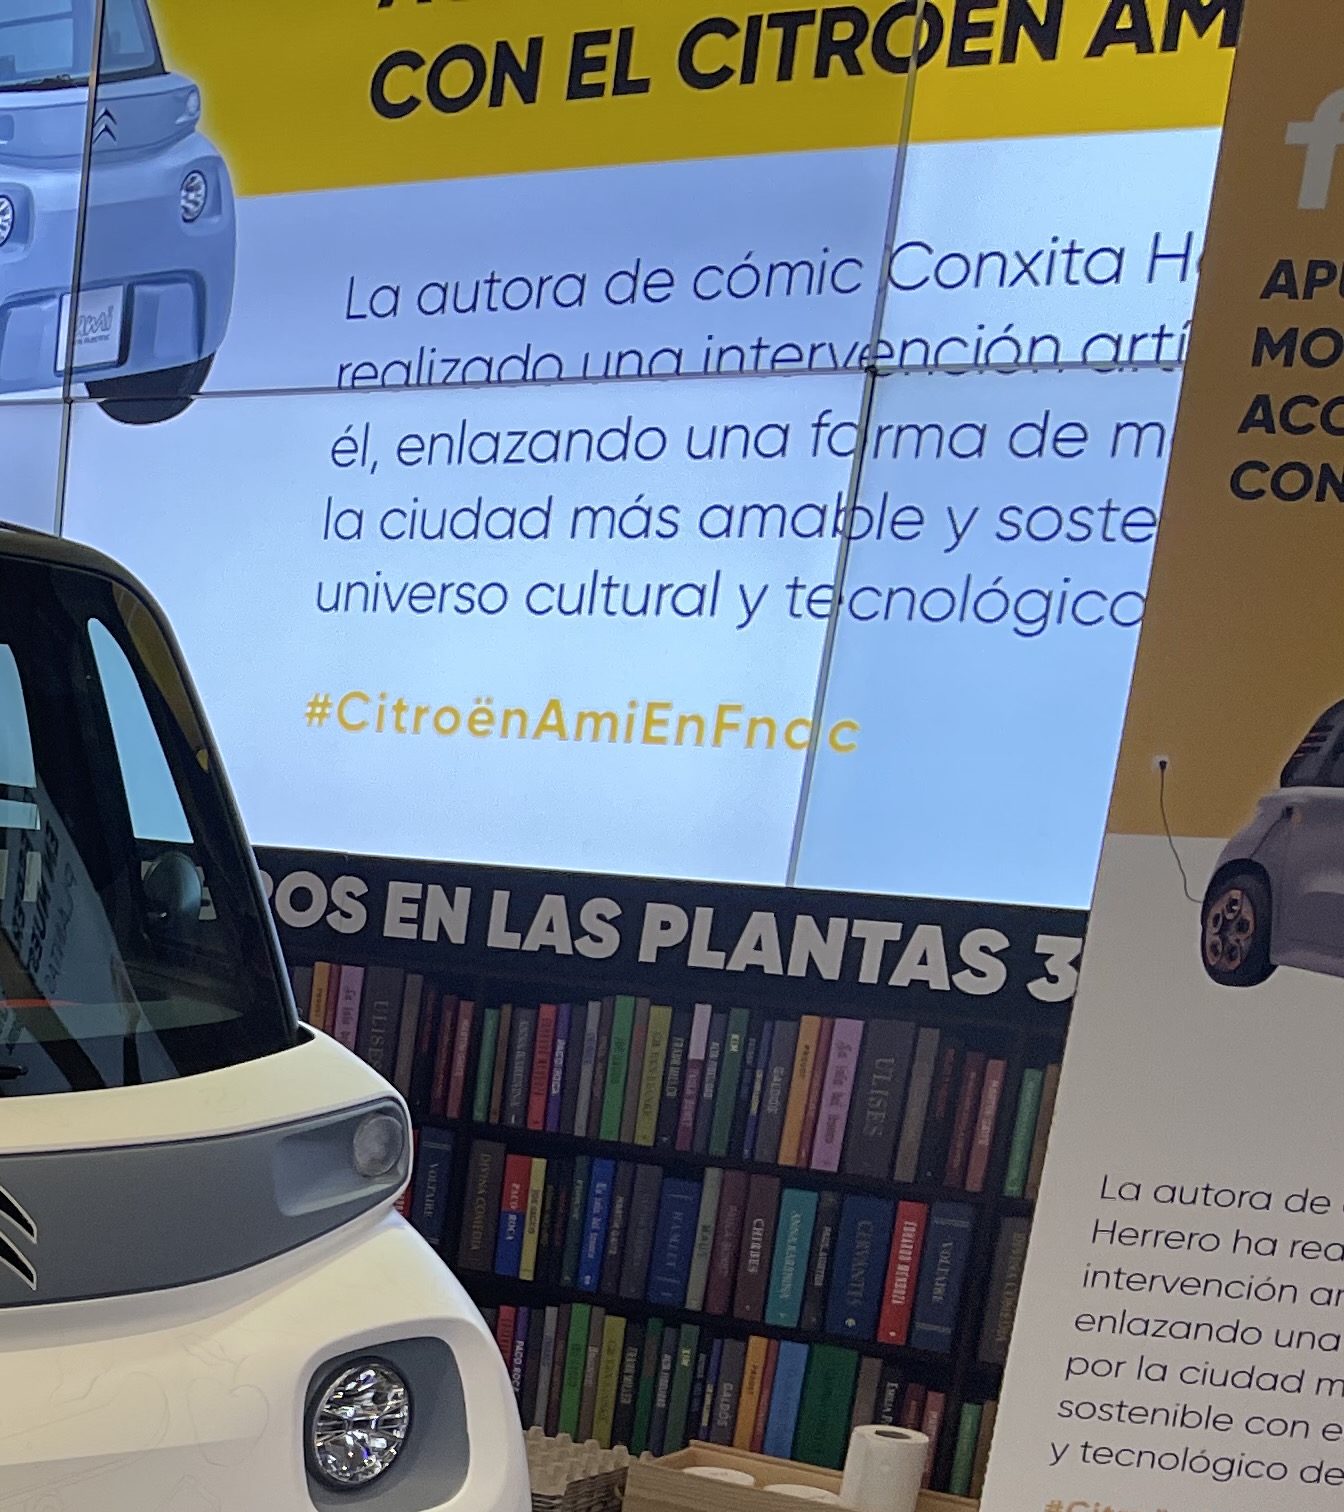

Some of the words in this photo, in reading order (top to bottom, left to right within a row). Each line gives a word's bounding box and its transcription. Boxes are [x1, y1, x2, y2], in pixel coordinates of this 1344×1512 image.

[370, 36, 543, 120] CON
[566, 27, 651, 100] EL
[344, 274, 400, 320] La
[417, 264, 587, 317] autora
[605, 256, 674, 305] de
[694, 246, 862, 299] cómic
[879, 234, 1124, 294] Conxita
[1146, 230, 1201, 284] H
[581, 350, 683, 381] una
[331, 422, 378, 470] él,
[396, 418, 667, 469] enlazando
[686, 418, 792, 461] una
[810, 405, 987, 461] forma
[1009, 409, 1088, 460] de
[322, 494, 365, 541] la
[380, 492, 553, 542] ciudad
[570, 494, 680, 541] más
[698, 490, 925, 542] amable
[943, 503, 980, 553] y
[316, 571, 509, 617] universo
[524, 571, 719, 618] cultural
[736, 583, 770, 629] y
[304, 689, 861, 757] #CitroënAmiEnFnac
[383, 880, 473, 945] EN
[486, 889, 622, 961] LAS
[639, 903, 1009, 996] PLANTAS
[1027, 932, 1082, 1003] 3
[863, 1057, 896, 1137] ULISES
[424, 1162, 440, 1218] VOLTAIRE
[1100, 1174, 1141, 1201] La
[1153, 1183, 1271, 1212] autora
[1284, 1188, 1331, 1215] de
[748, 1218, 765, 1275] CHIRBES
[846, 1219, 874, 1305] CERVANTES
[1092, 1219, 1220, 1252] Herrero
[1233, 1229, 1277, 1257] ha
[931, 1241, 954, 1304] VOLTAIRE
[1083, 1263, 1298, 1304] intervención
[515, 1340, 525, 1366] PACO
[1074, 1310, 1262, 1346] enlazando
[1274, 1328, 1341, 1352] una
[1065, 1355, 1127, 1380] por
[1137, 1355, 1168, 1382] la
[1179, 1361, 1305, 1394] ciudad
[717, 1382, 734, 1428] GALDÓS
[1057, 1398, 1234, 1432] sostenible
[1245, 1416, 1310, 1440] con
[1049, 1441, 1069, 1467] y
[1081, 1440, 1288, 1482] tecnológico
[1299, 1461, 1344, 1487] de
